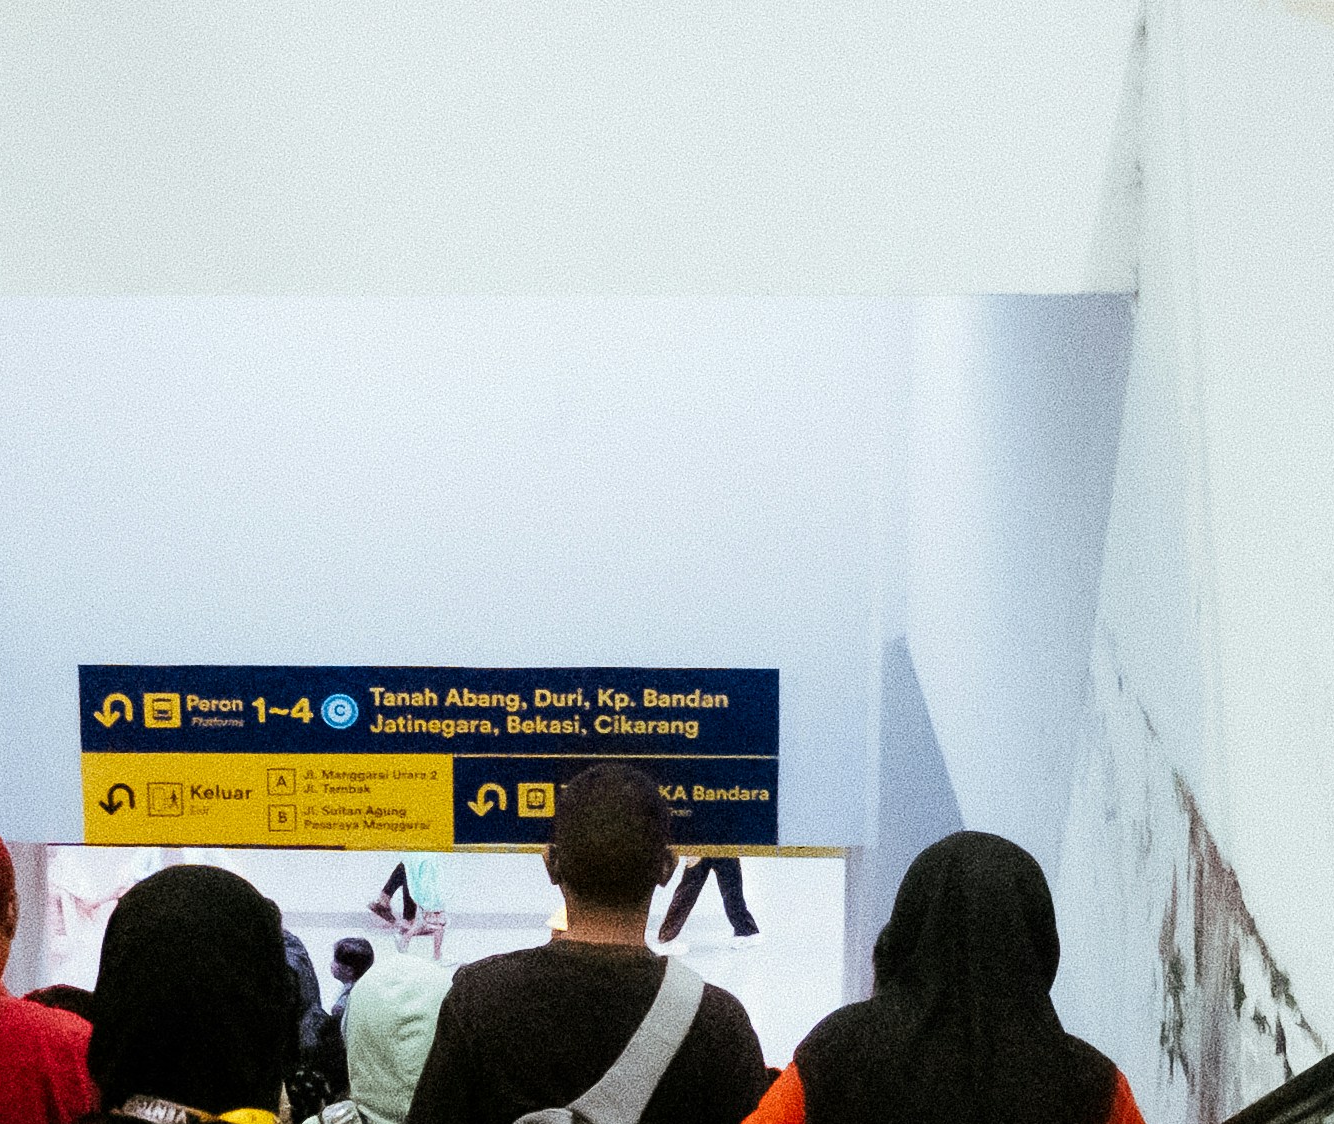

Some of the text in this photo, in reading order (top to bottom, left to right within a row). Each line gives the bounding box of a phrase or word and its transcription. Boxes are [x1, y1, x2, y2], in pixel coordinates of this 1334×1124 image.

[186, 694, 244, 711] Peron
[369, 687, 729, 712] Tanah Abang, Duri, Kp. Bandan
[333, 704, 346, 716] C
[369, 714, 699, 739] Jatinegara, Bekasi, Cikarang
[276, 775, 287, 787] A
[430, 770, 438, 780] 2
[190, 784, 253, 800] Keluar
[692, 784, 770, 801] Bandara
[278, 811, 288, 823] B
[366, 805, 407, 818] Agung
